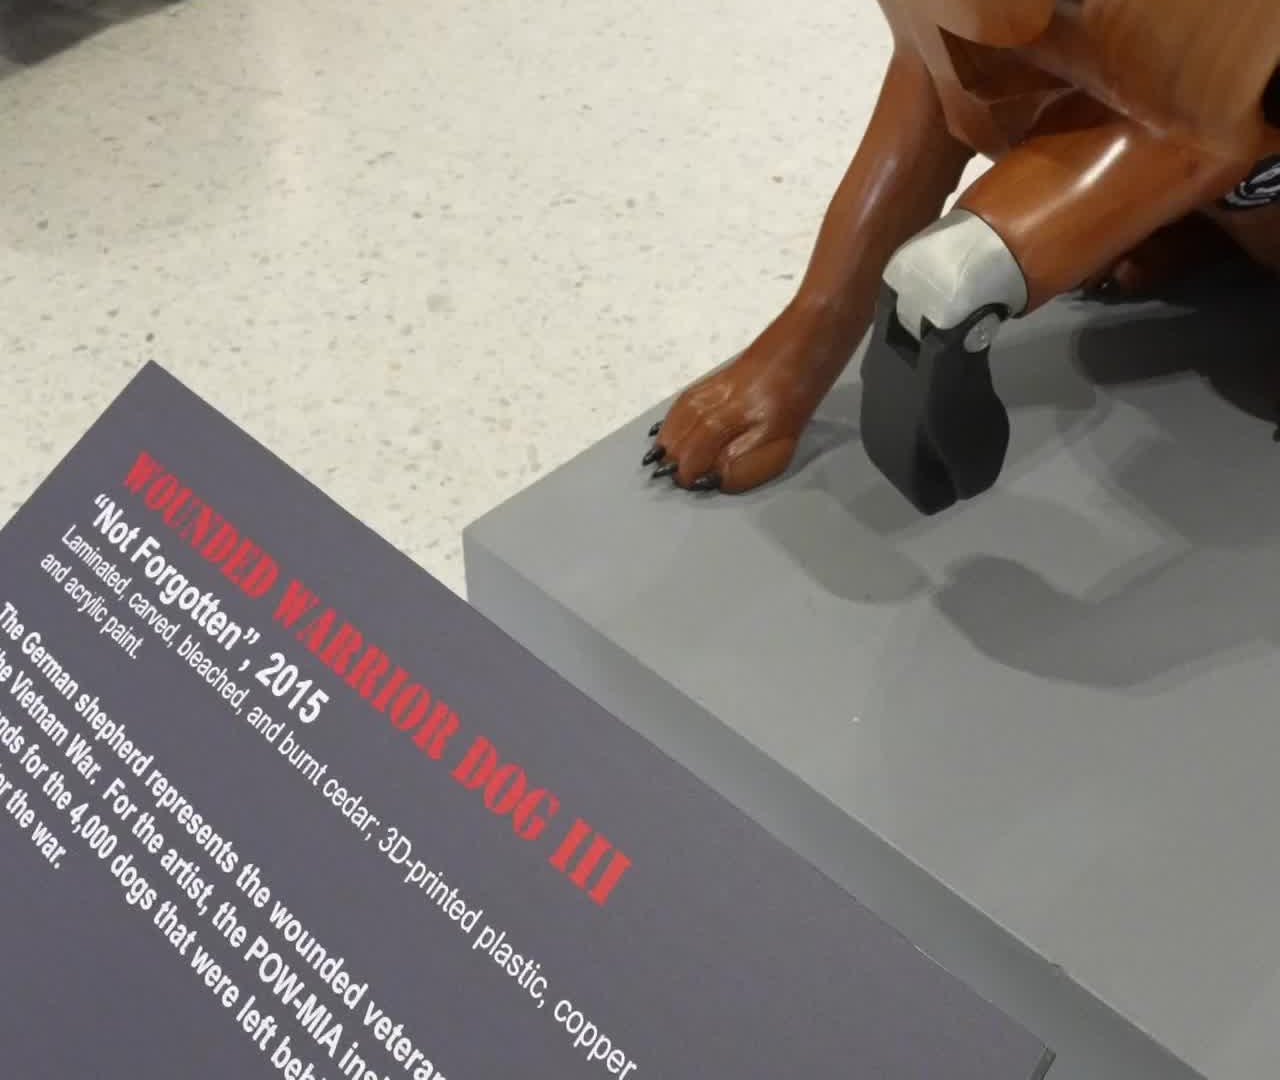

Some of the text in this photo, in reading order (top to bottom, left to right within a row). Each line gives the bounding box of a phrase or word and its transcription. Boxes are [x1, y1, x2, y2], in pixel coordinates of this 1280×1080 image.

[41, 554, 144, 659] and acrylic paint.
[124, 451, 631, 905] WOUNDED WARRIOR DOG III
[255, 652, 329, 723] 2015
[6, 789, 35, 828] the
[32, 821, 66, 869] war.
[10, 670, 69, 746] Vietnam
[65, 733, 101, 785] War.
[102, 778, 138, 821] For
[132, 812, 164, 853] the
[160, 849, 214, 916] artist,
[212, 902, 247, 947] the
[244, 936, 343, 1058] POW-MIA
[20, 744, 49, 779] for
[43, 771, 72, 810] the
[70, 803, 117, 859] 4,000
[111, 854, 157, 910] dogs
[154, 901, 197, 955] that
[191, 945, 239, 1007] were
[236, 995, 278, 1051] left
[271, 1036, 326, 1080] beh
[22, 632, 78, 700] German
[75, 694, 154, 776] shepherd
[144, 769, 238, 872] represents
[236, 864, 270, 908] the
[269, 901, 368, 1010] wounded
[62, 524, 637, 1080] Laminated, carved, bleached, and burnt cedar; 3D-printed plastic, copper
